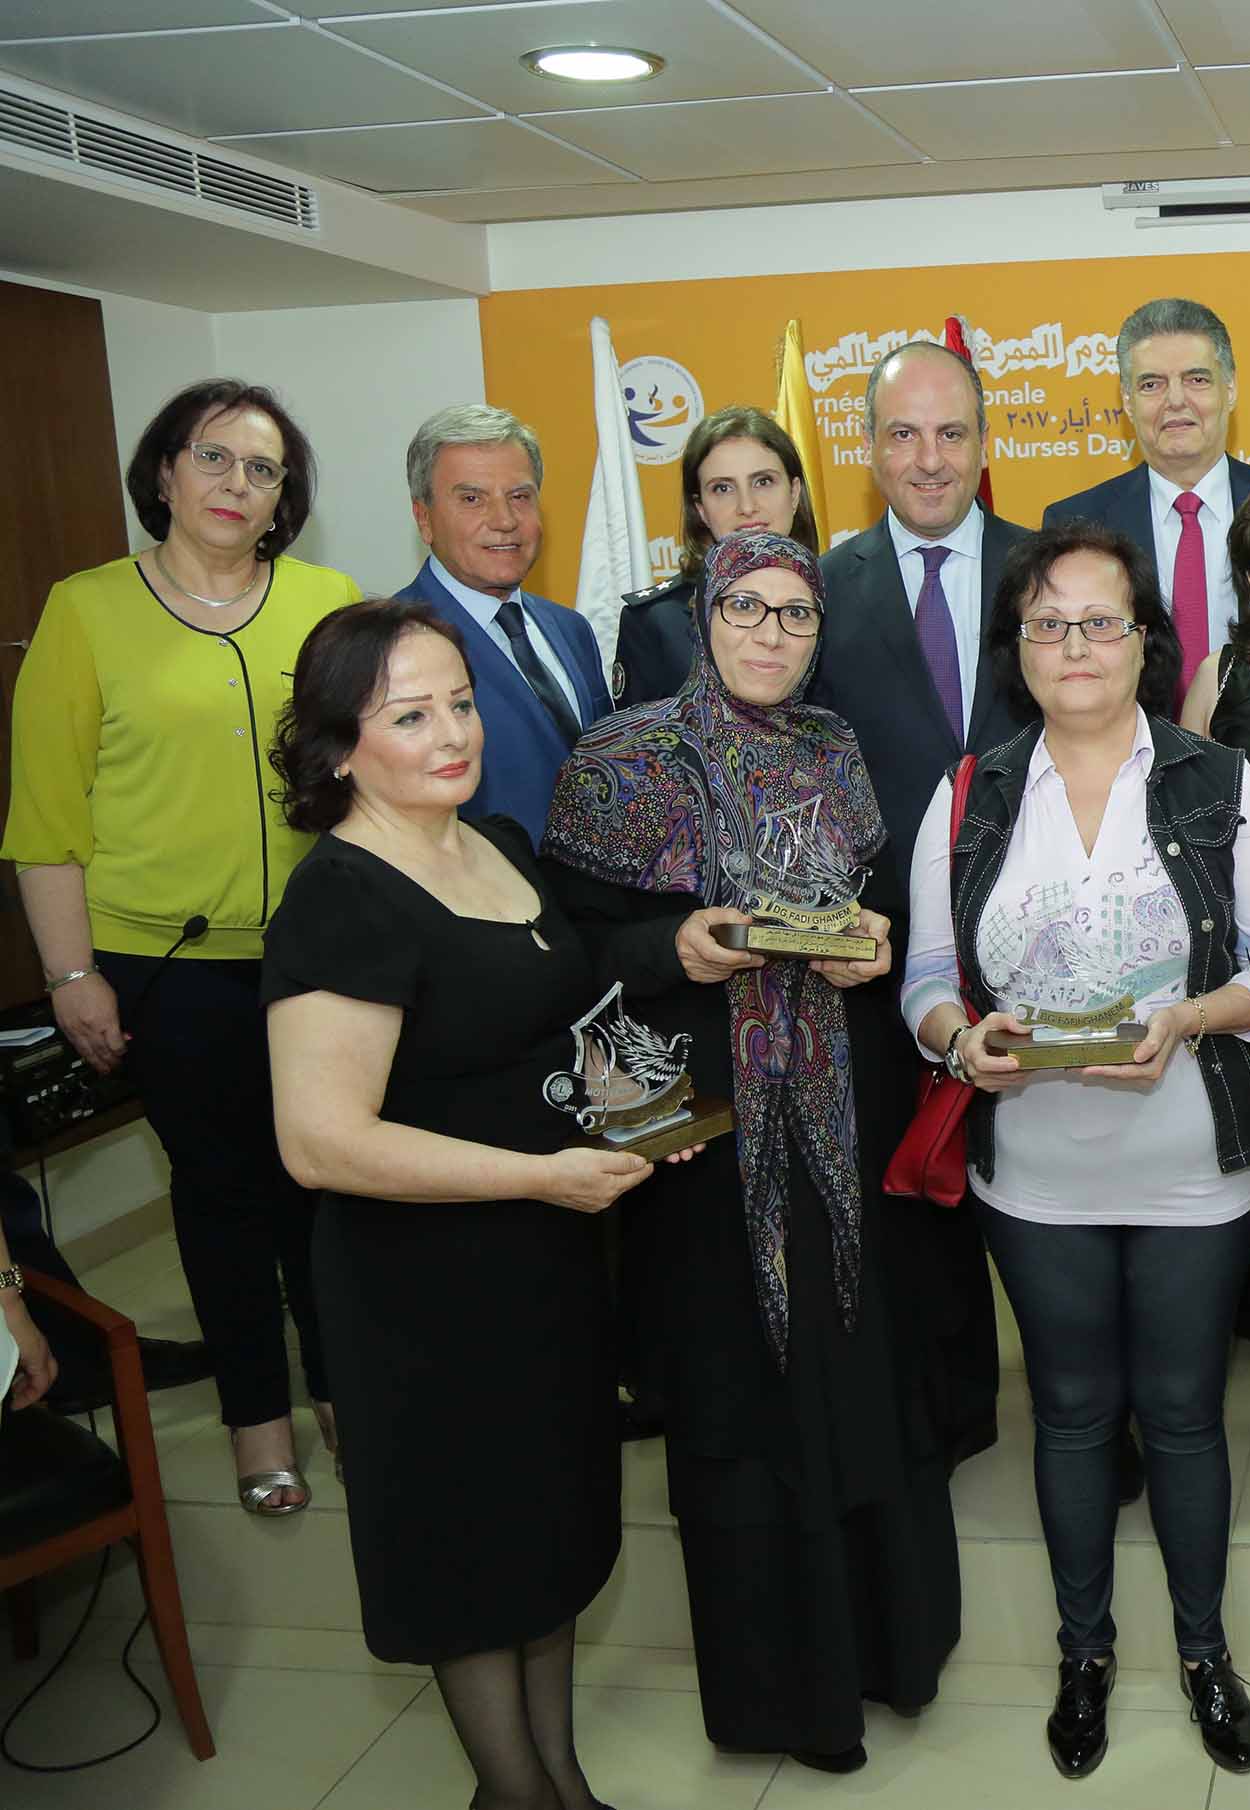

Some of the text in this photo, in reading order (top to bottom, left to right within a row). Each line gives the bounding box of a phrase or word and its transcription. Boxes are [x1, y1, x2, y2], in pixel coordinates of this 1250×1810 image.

[976, 328, 1061, 373] الممرض
[814, 389, 865, 413] rnée
[1006, 409, 1049, 430] ٢٠١٧
[1058, 396, 1092, 434] أيار
[994, 432, 1137, 462] Nurses Day
[812, 906, 852, 924] GHANEM
